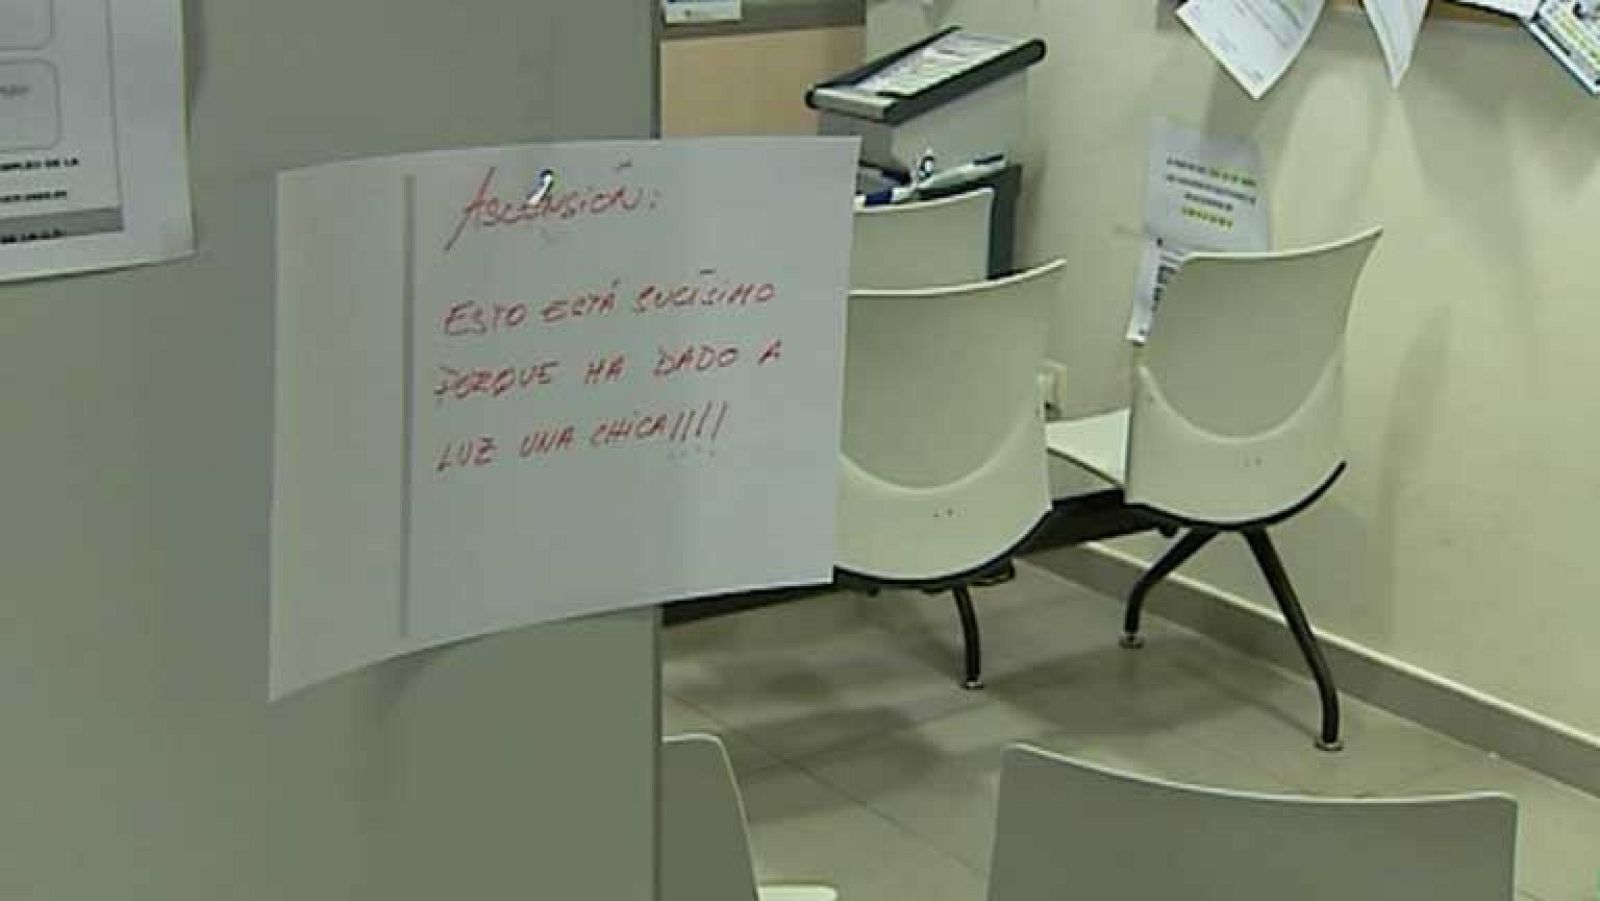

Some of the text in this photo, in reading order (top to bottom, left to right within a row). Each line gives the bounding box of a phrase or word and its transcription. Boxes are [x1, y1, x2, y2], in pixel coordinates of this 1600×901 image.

[444, 301, 527, 336] ESTO
[433, 340, 783, 404] PORQUE HA DADO A
[436, 436, 498, 472] LUZ
[518, 425, 577, 458] UNA
